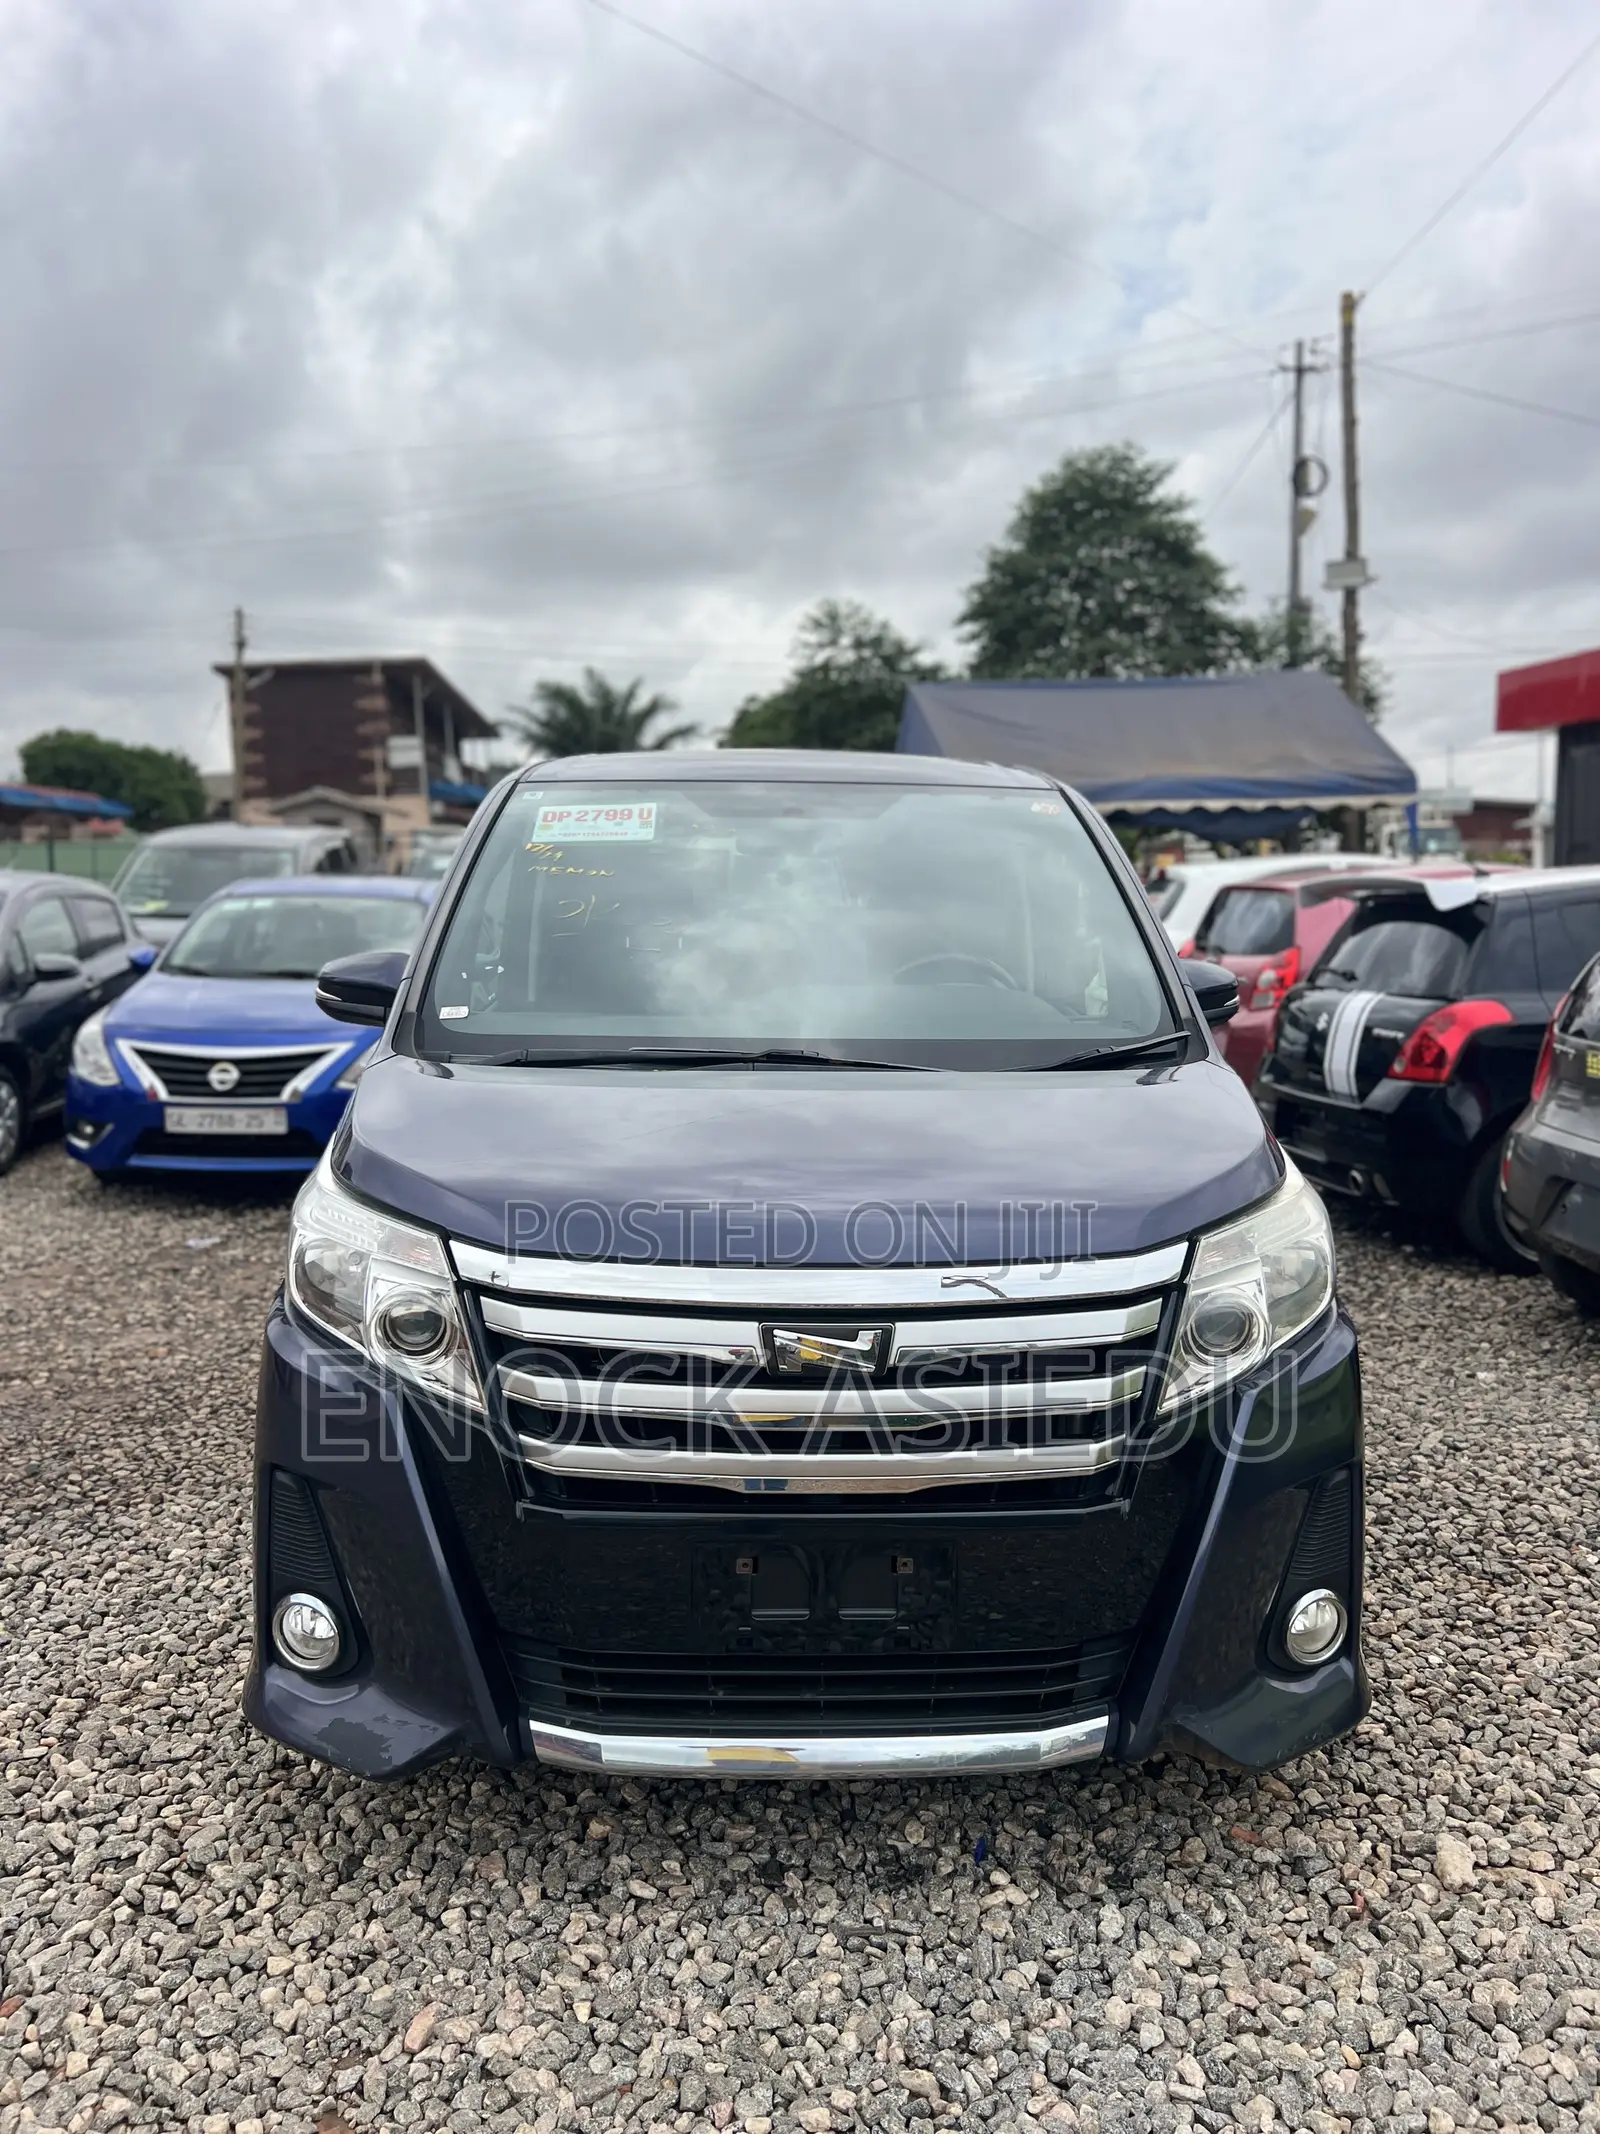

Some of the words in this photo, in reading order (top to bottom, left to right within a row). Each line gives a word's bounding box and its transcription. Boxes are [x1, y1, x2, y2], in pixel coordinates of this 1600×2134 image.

[541, 810, 573, 824] DP
[574, 808, 633, 822] 2799
[638, 807, 653, 820] U
